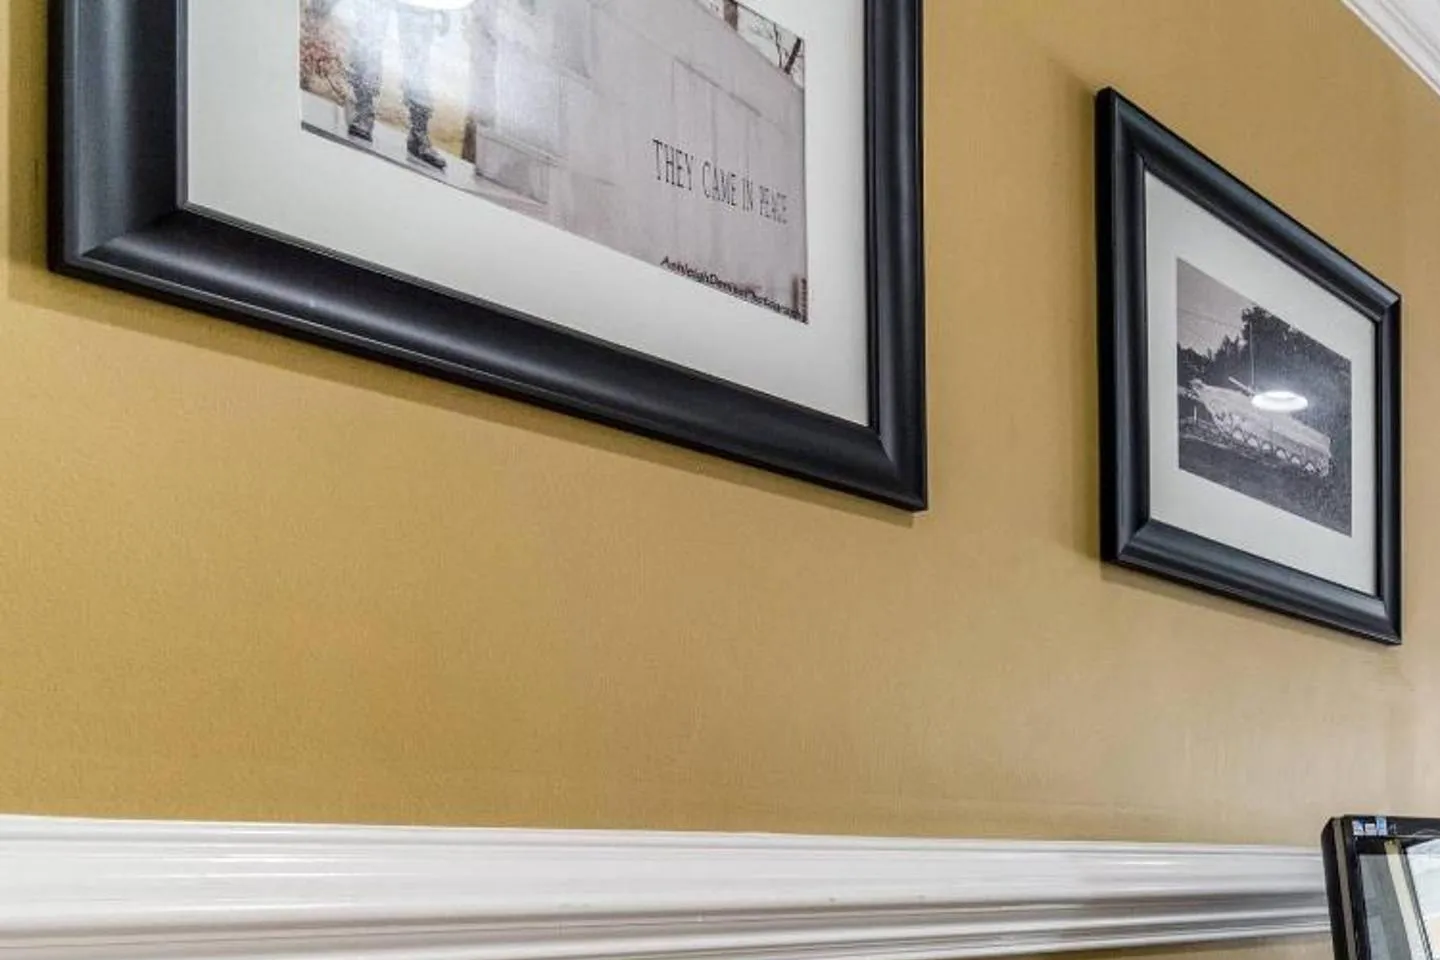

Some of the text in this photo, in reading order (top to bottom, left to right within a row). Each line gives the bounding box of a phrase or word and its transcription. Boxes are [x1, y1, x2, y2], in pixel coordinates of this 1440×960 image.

[652, 138, 695, 191] THEY
[701, 160, 737, 207] CAME
[742, 177, 754, 212] IN
